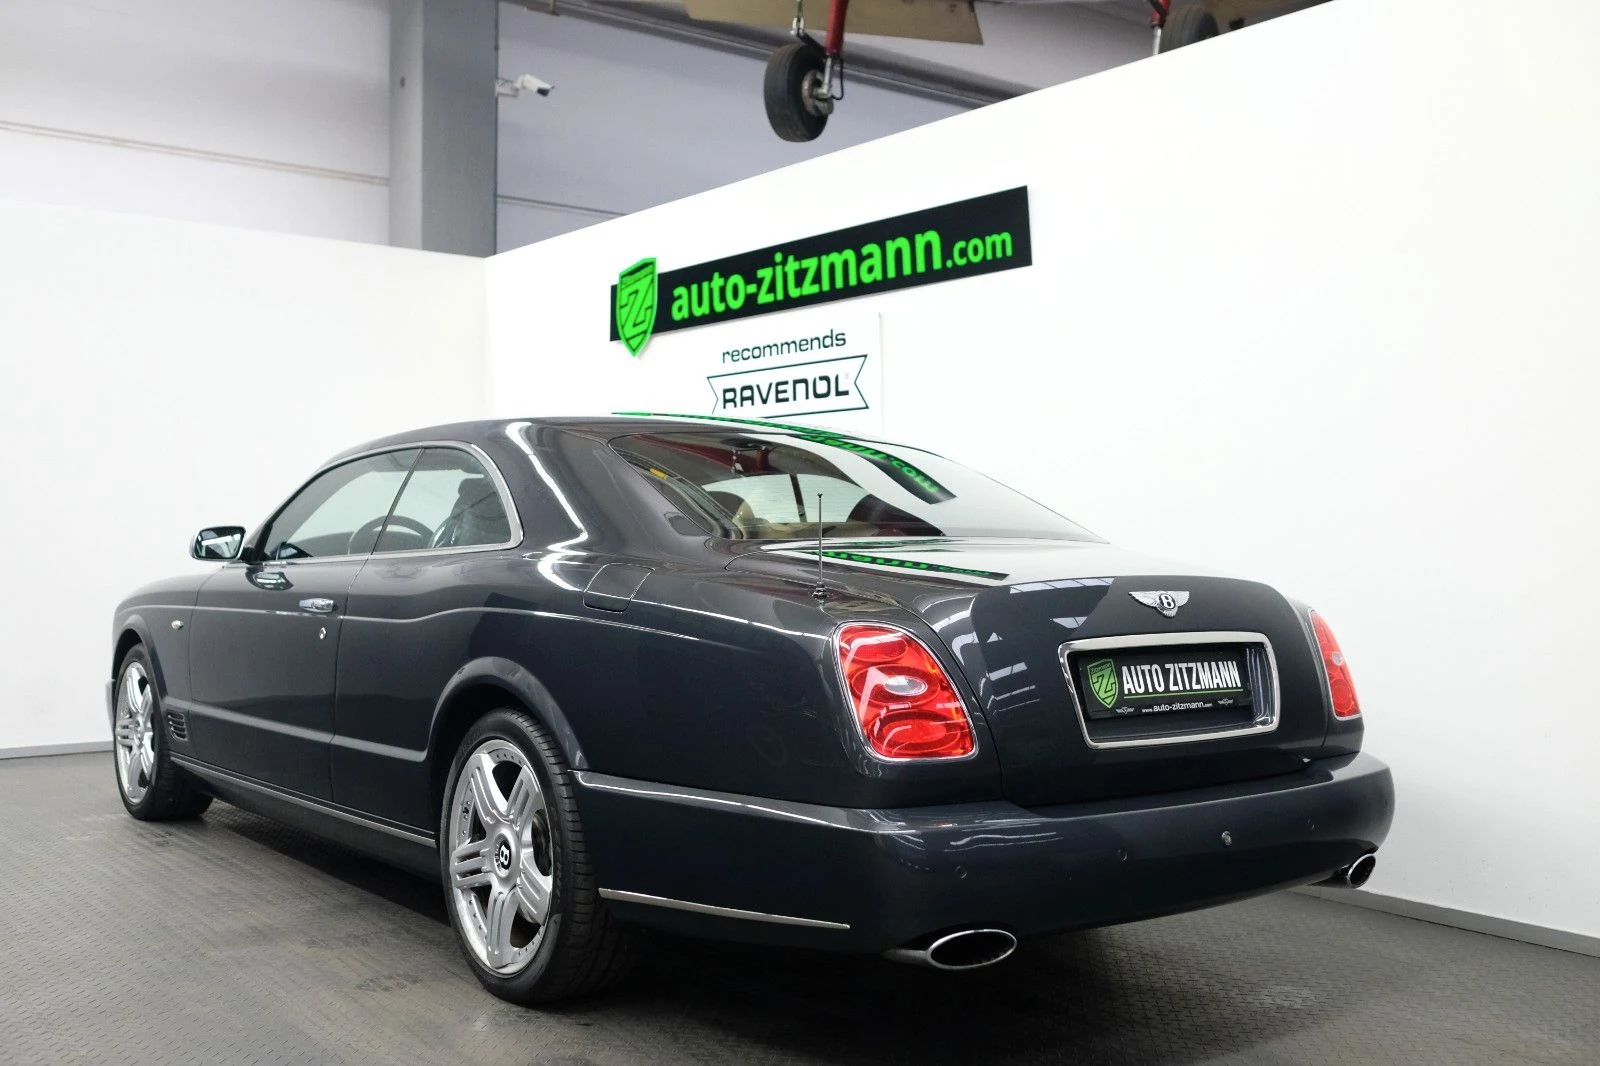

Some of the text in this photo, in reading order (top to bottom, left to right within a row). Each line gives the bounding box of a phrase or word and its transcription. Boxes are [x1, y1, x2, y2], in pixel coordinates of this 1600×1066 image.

[671, 228, 1013, 321] auto-zitzmann.com
[722, 328, 847, 364] recommends
[722, 373, 850, 410] RAVENOL
[1121, 661, 1241, 694] AUTO ZITZMANN
[1142, 701, 1212, 712] www.auto-zitzmann.com
